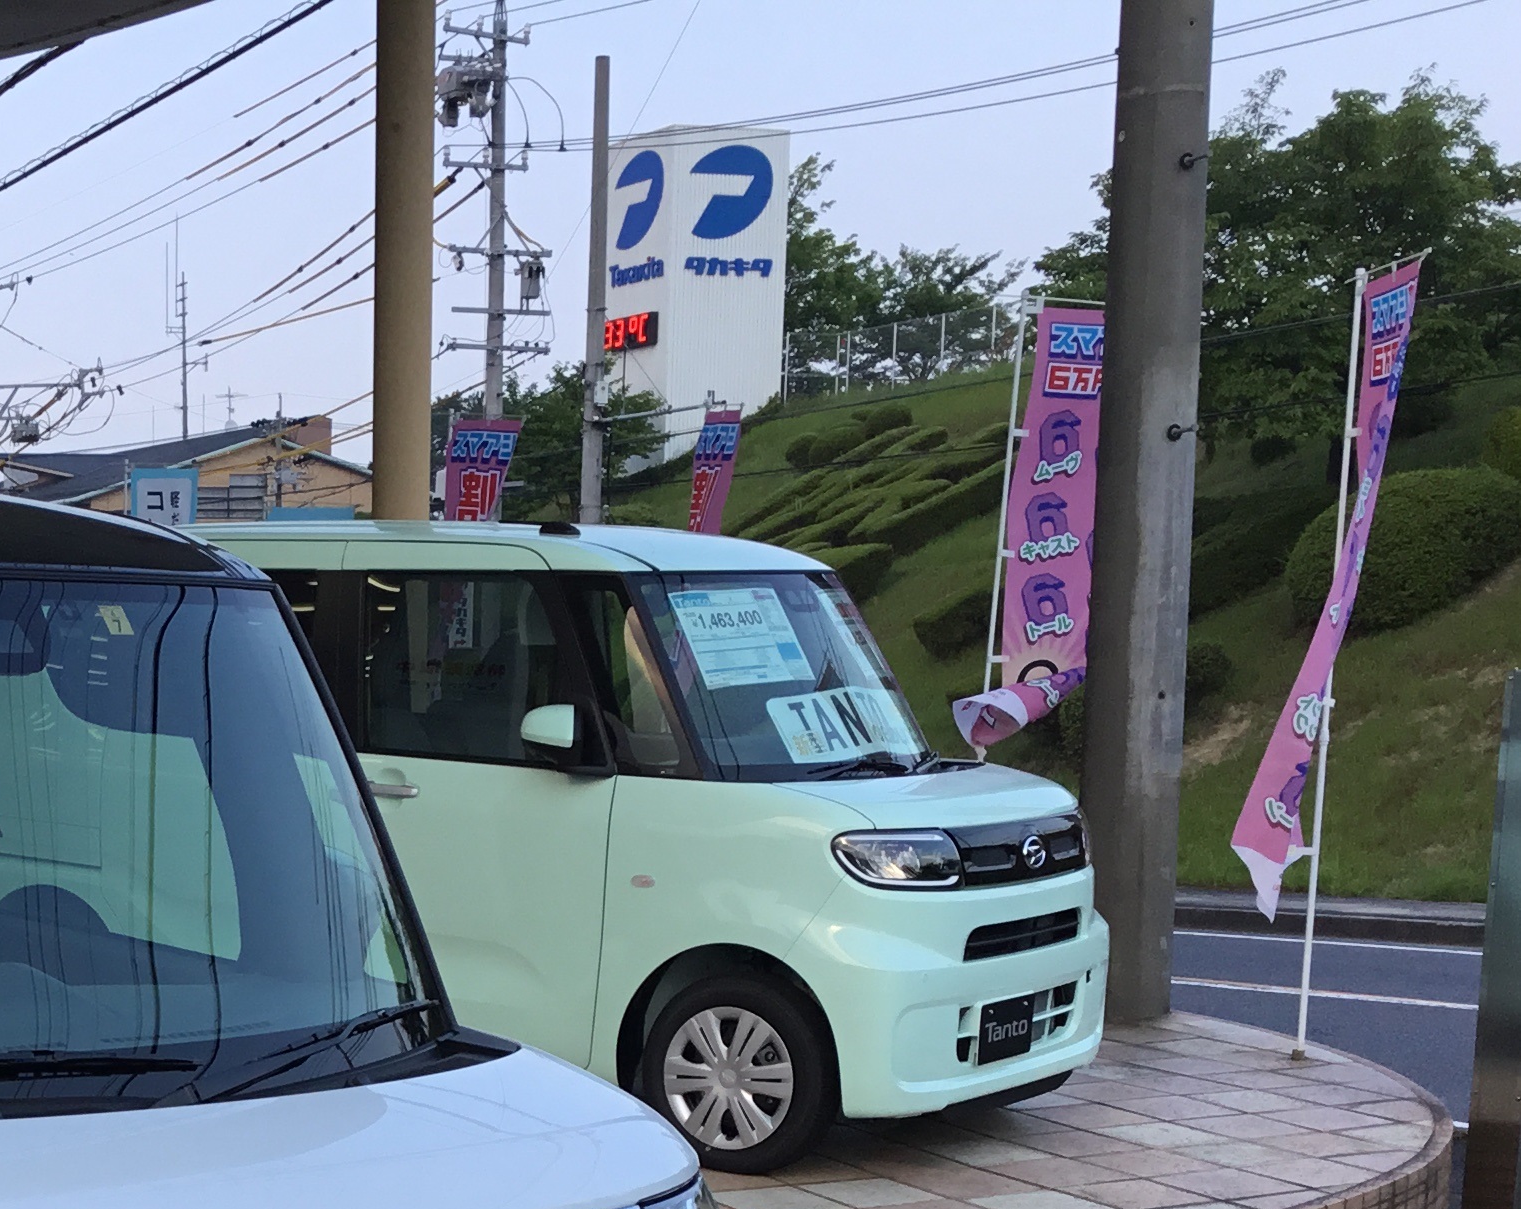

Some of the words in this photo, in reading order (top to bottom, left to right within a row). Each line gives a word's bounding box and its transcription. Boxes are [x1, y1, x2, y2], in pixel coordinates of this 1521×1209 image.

[684, 256, 773, 278] タカキタ
[1034, 451, 1082, 482] ムーヴ
[1020, 532, 1080, 560] キャスト
[1026, 614, 1073, 641] トール
[985, 1019, 1028, 1043] Tanto
